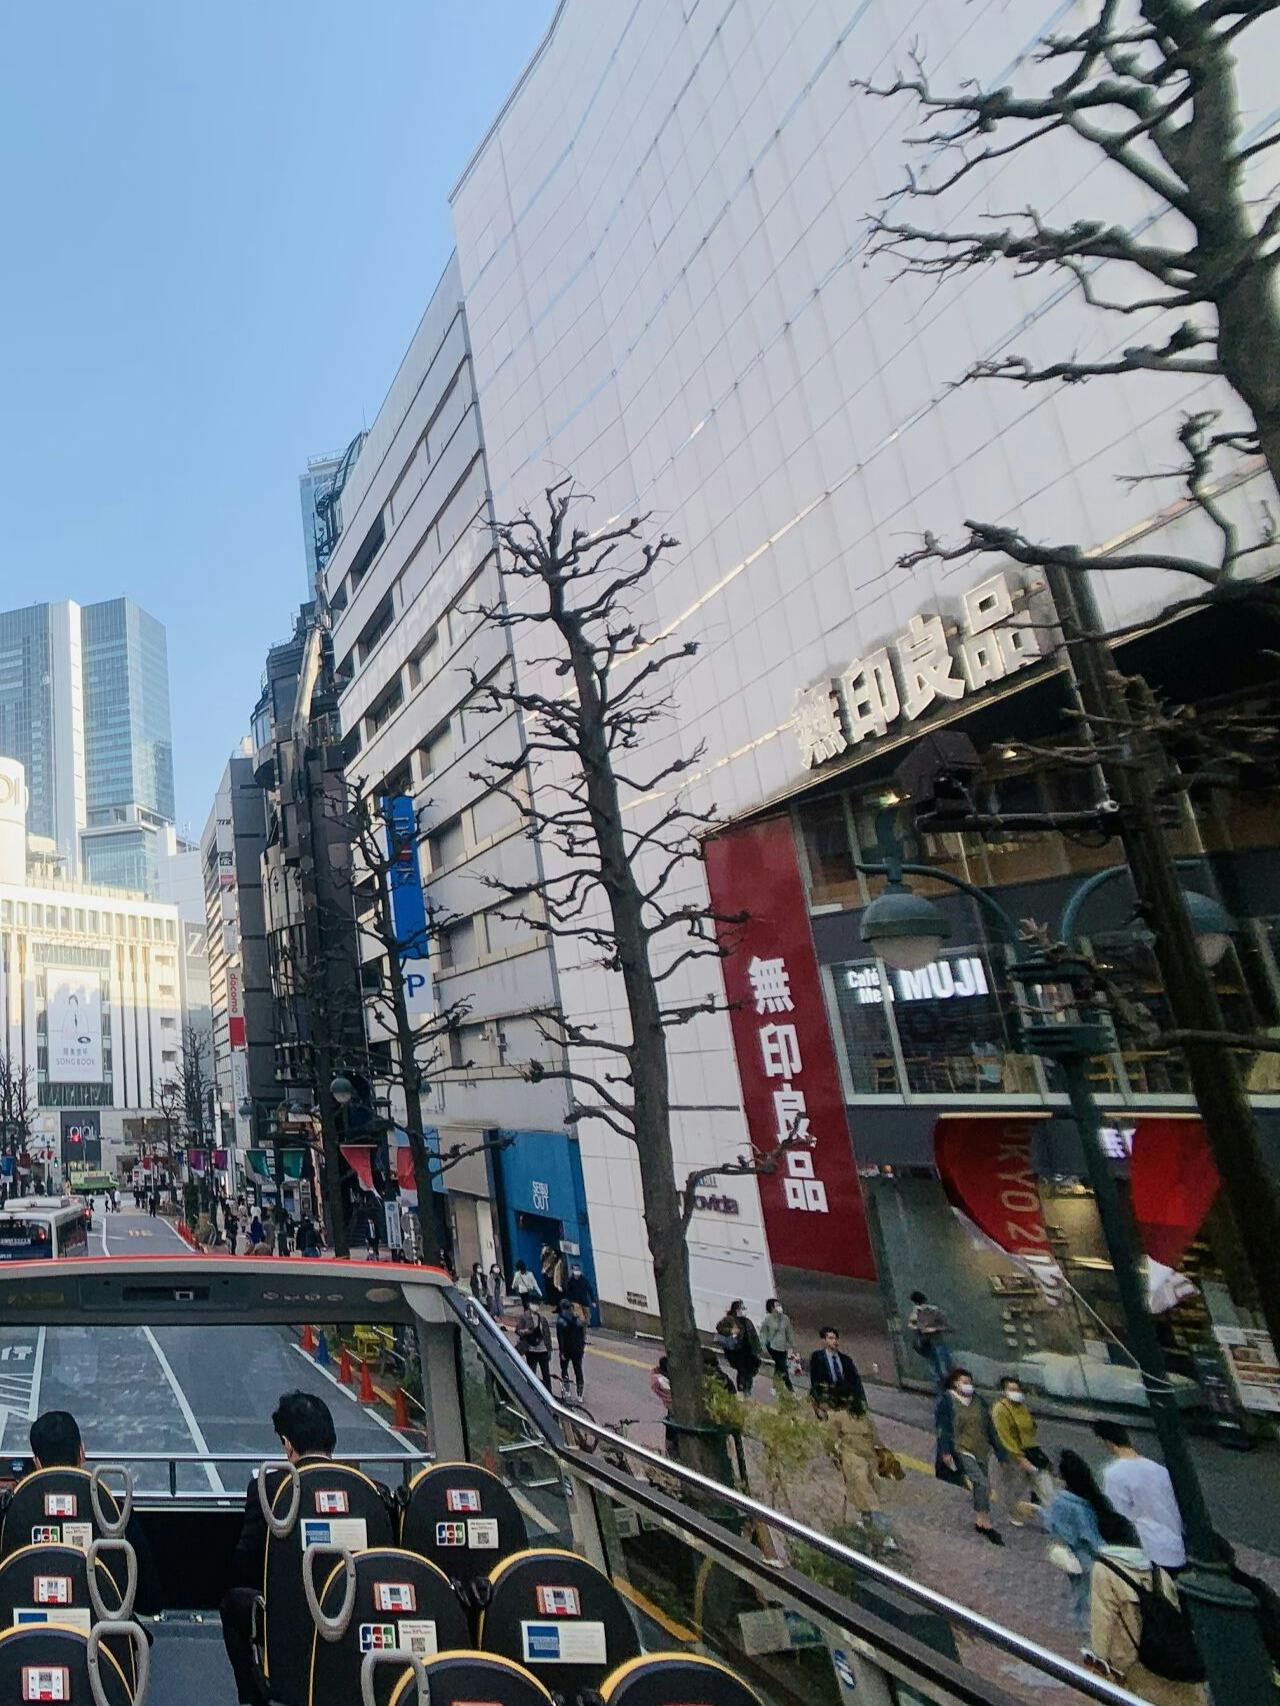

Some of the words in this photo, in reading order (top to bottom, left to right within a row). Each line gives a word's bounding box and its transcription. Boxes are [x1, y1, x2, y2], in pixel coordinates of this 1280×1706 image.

[793, 571, 1043, 770] 無印良品
[407, 974, 426, 998] P
[846, 966, 880, 988] Café
[899, 957, 990, 1001] MUJI
[230, 973, 239, 1014] docomo
[858, 985, 896, 1004] Mel
[56, 1057, 95, 1066] SONGBOOK
[747, 955, 829, 1214] 無印良品
[532, 1193, 550, 1211] OUT
[694, 1194, 739, 1215] ovida
